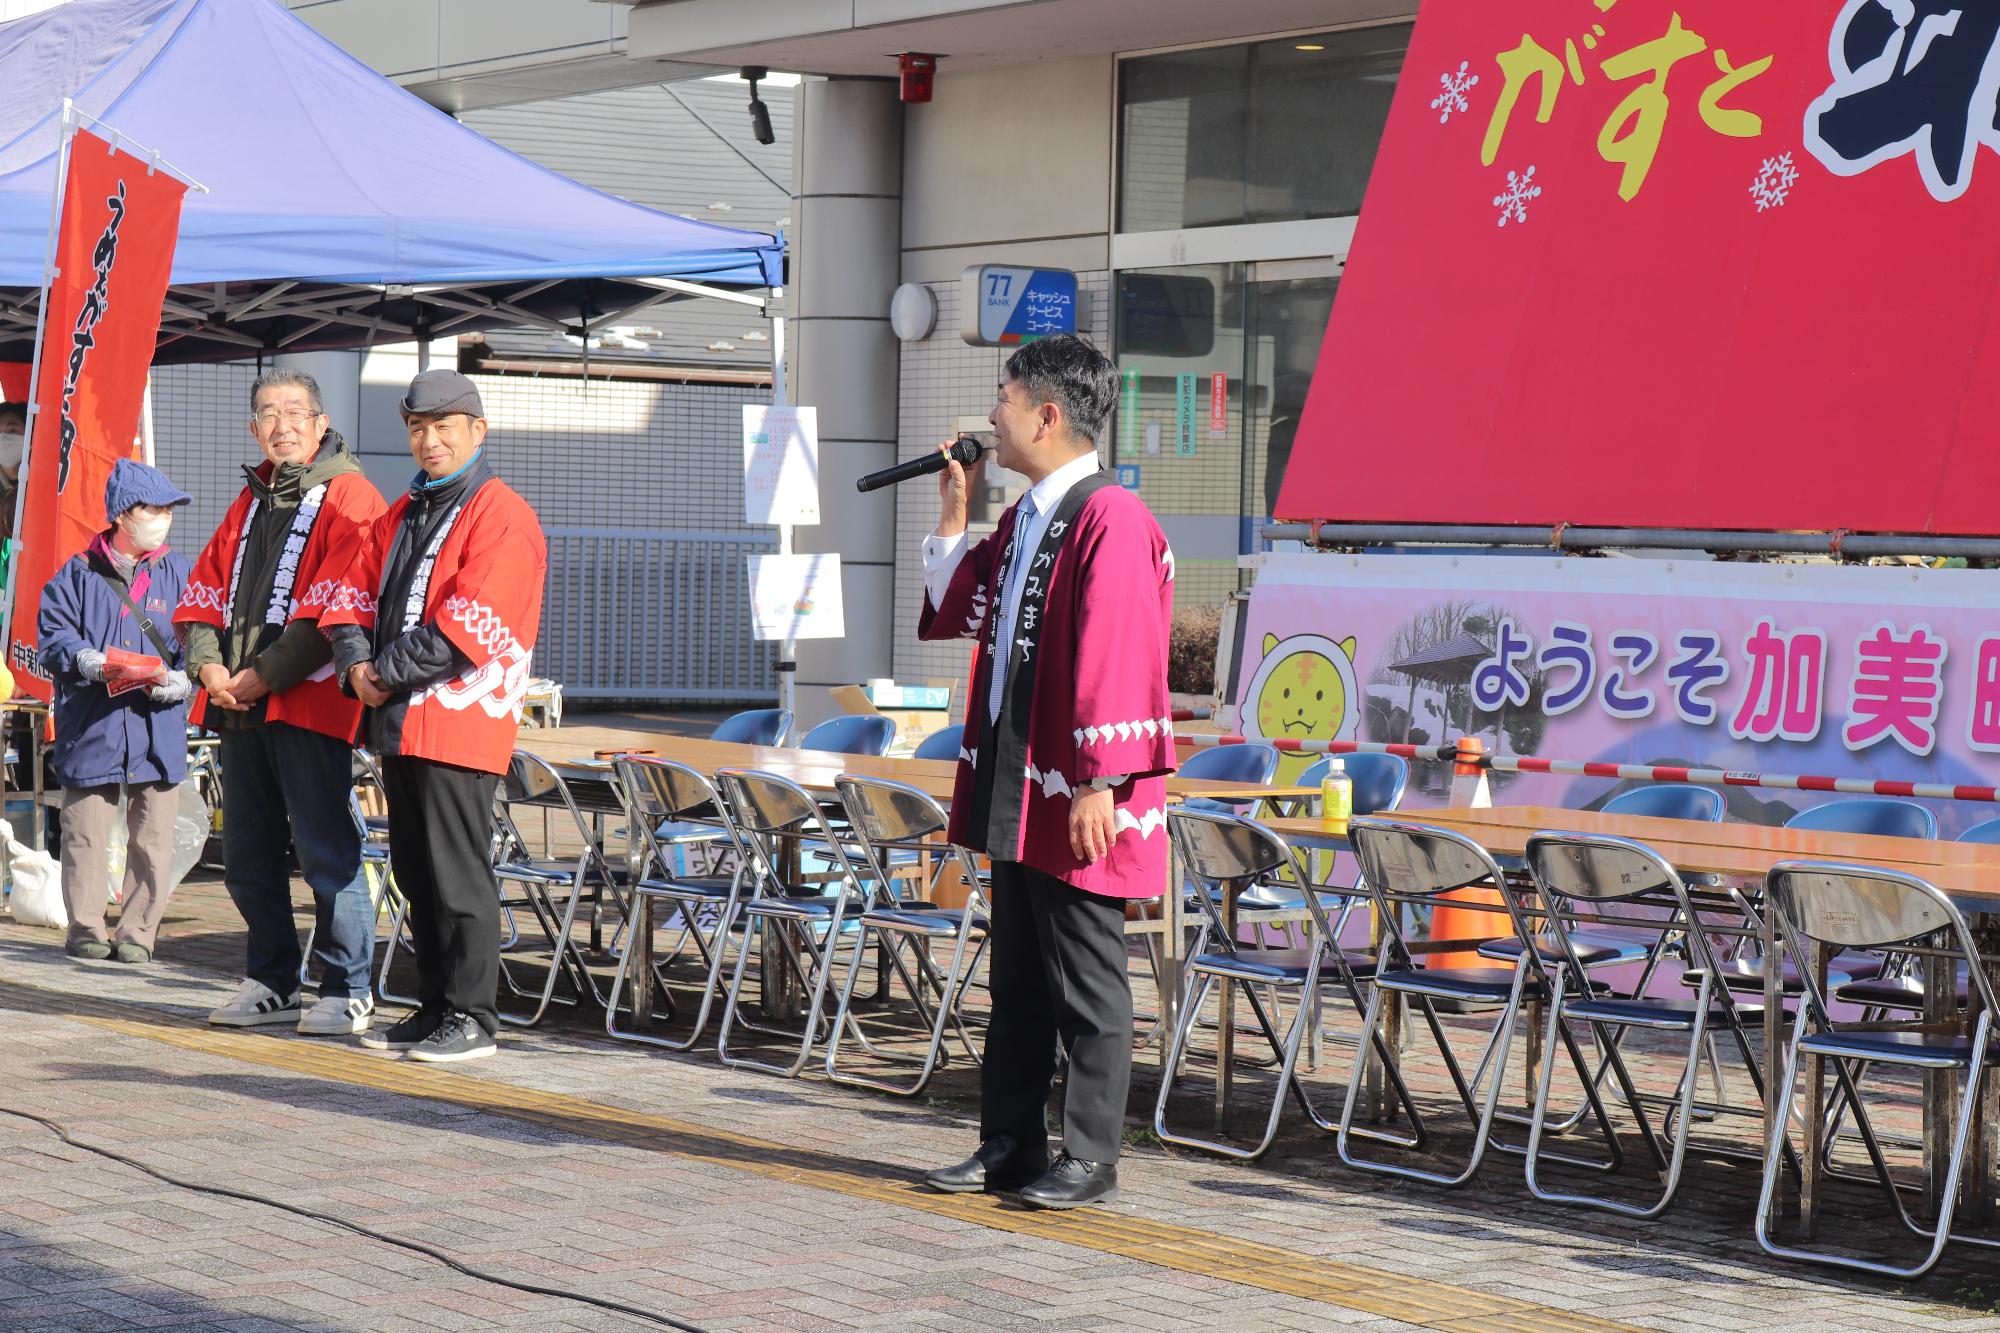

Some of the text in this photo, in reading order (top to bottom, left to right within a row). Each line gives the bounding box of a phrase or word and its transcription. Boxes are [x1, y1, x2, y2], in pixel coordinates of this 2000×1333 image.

[987, 274, 1012, 297] 77
[987, 297, 1010, 306] BANK
[1027, 290, 1071, 305] キャッシュ
[1027, 304, 1064, 319] サービス
[1027, 319, 1063, 333] コーナー
